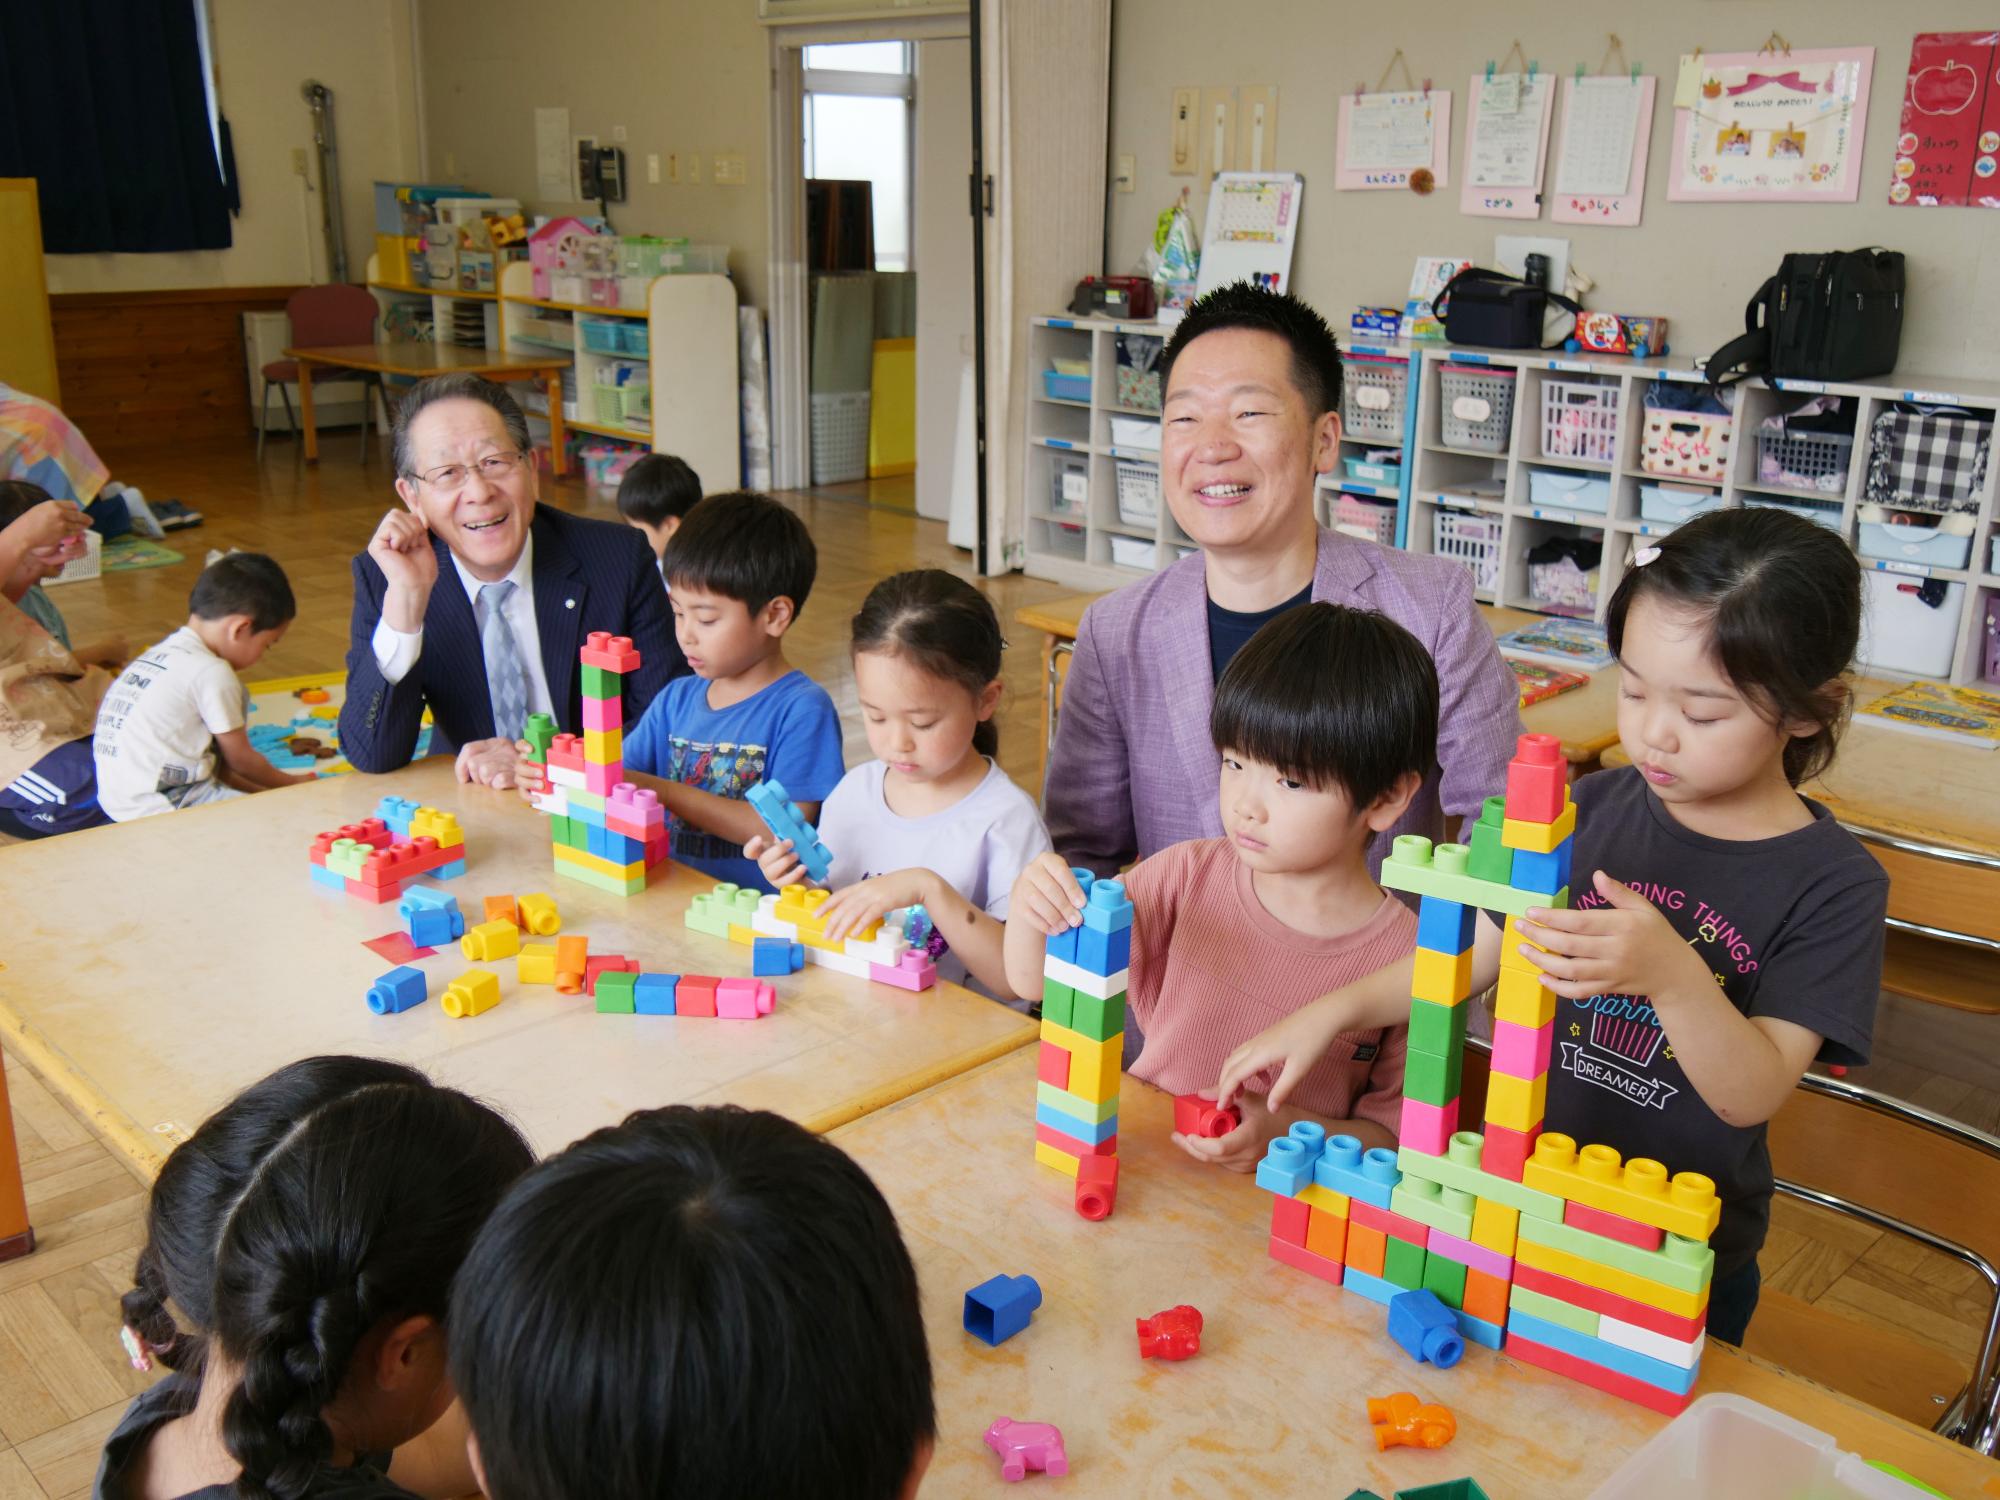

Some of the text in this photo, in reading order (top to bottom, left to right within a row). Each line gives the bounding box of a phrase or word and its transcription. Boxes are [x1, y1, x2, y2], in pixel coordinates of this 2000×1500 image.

[1577, 881, 1759, 974] INRING THINGS
[1577, 1059, 1649, 1100] DREAMER
